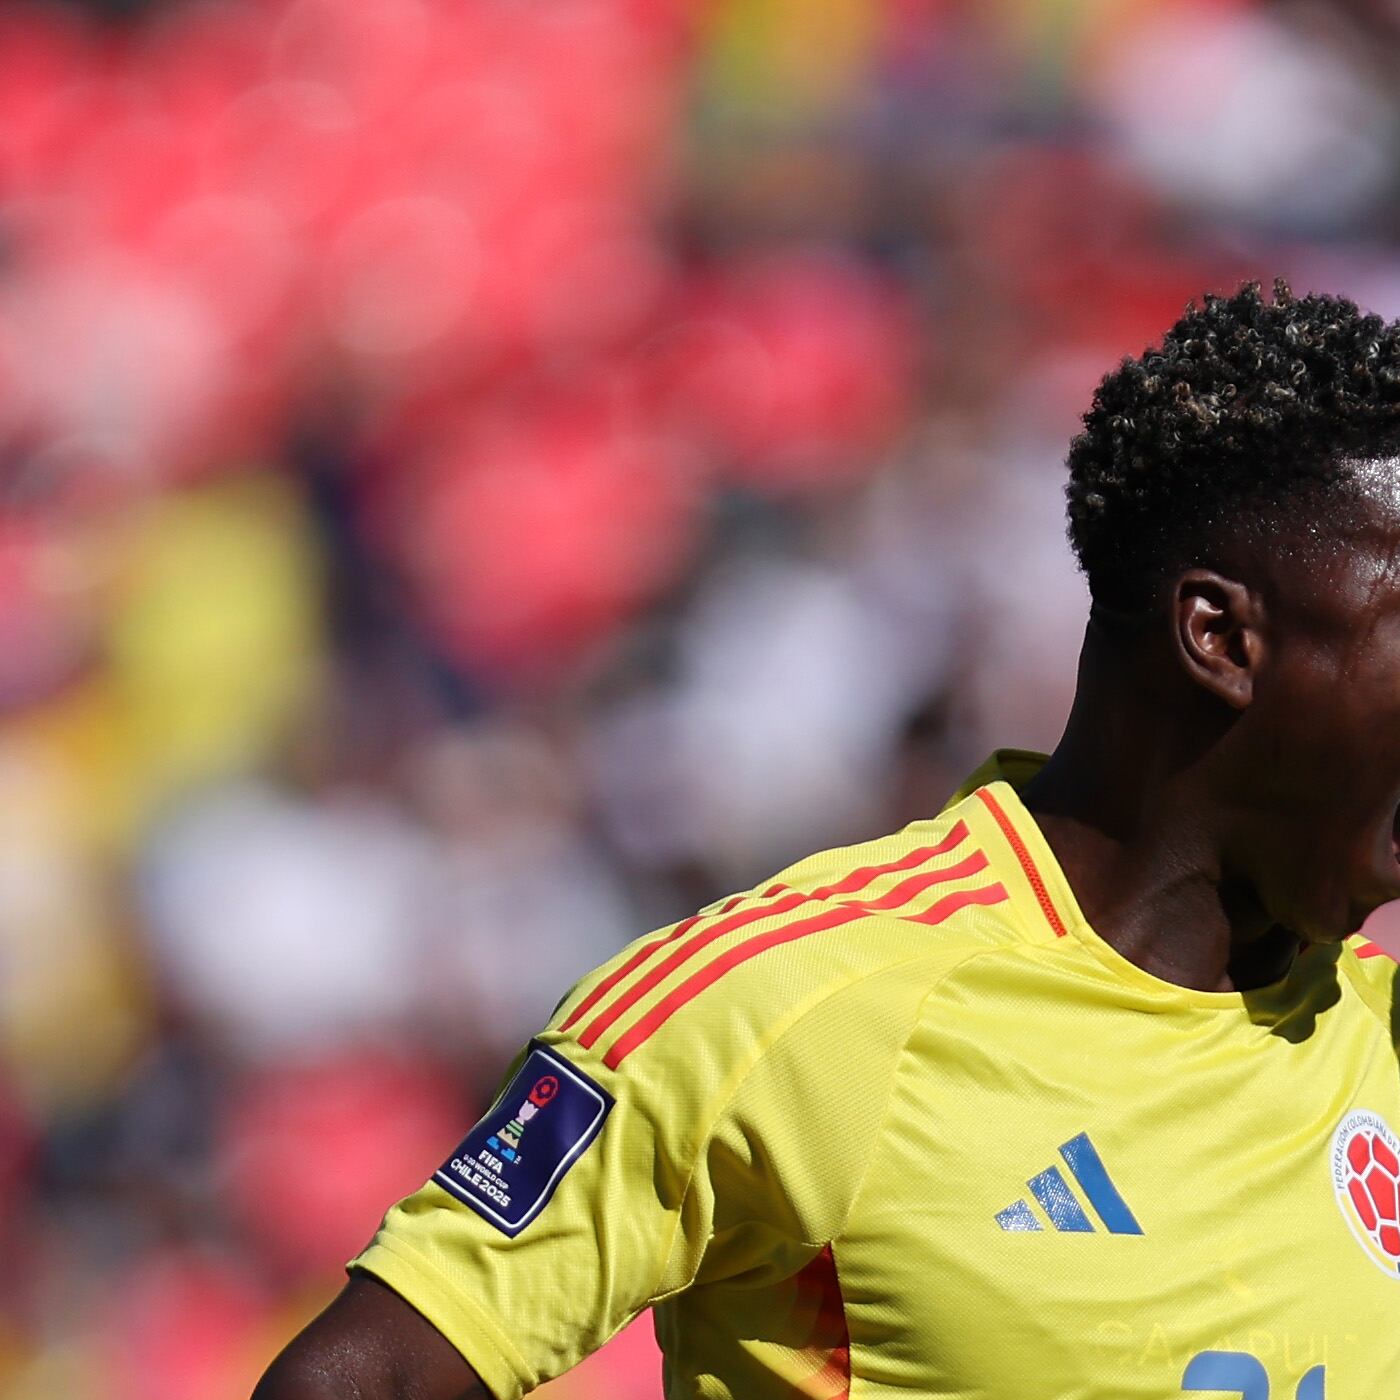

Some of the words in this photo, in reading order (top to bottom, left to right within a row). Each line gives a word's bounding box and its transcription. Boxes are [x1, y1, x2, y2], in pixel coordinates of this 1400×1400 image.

[478, 1149, 503, 1174] FIFA
[450, 1158, 483, 1186] CHILE
[478, 1178, 512, 1207] 2025
[474, 1162, 497, 1181] WORLD
[495, 1177, 509, 1190] CUP
